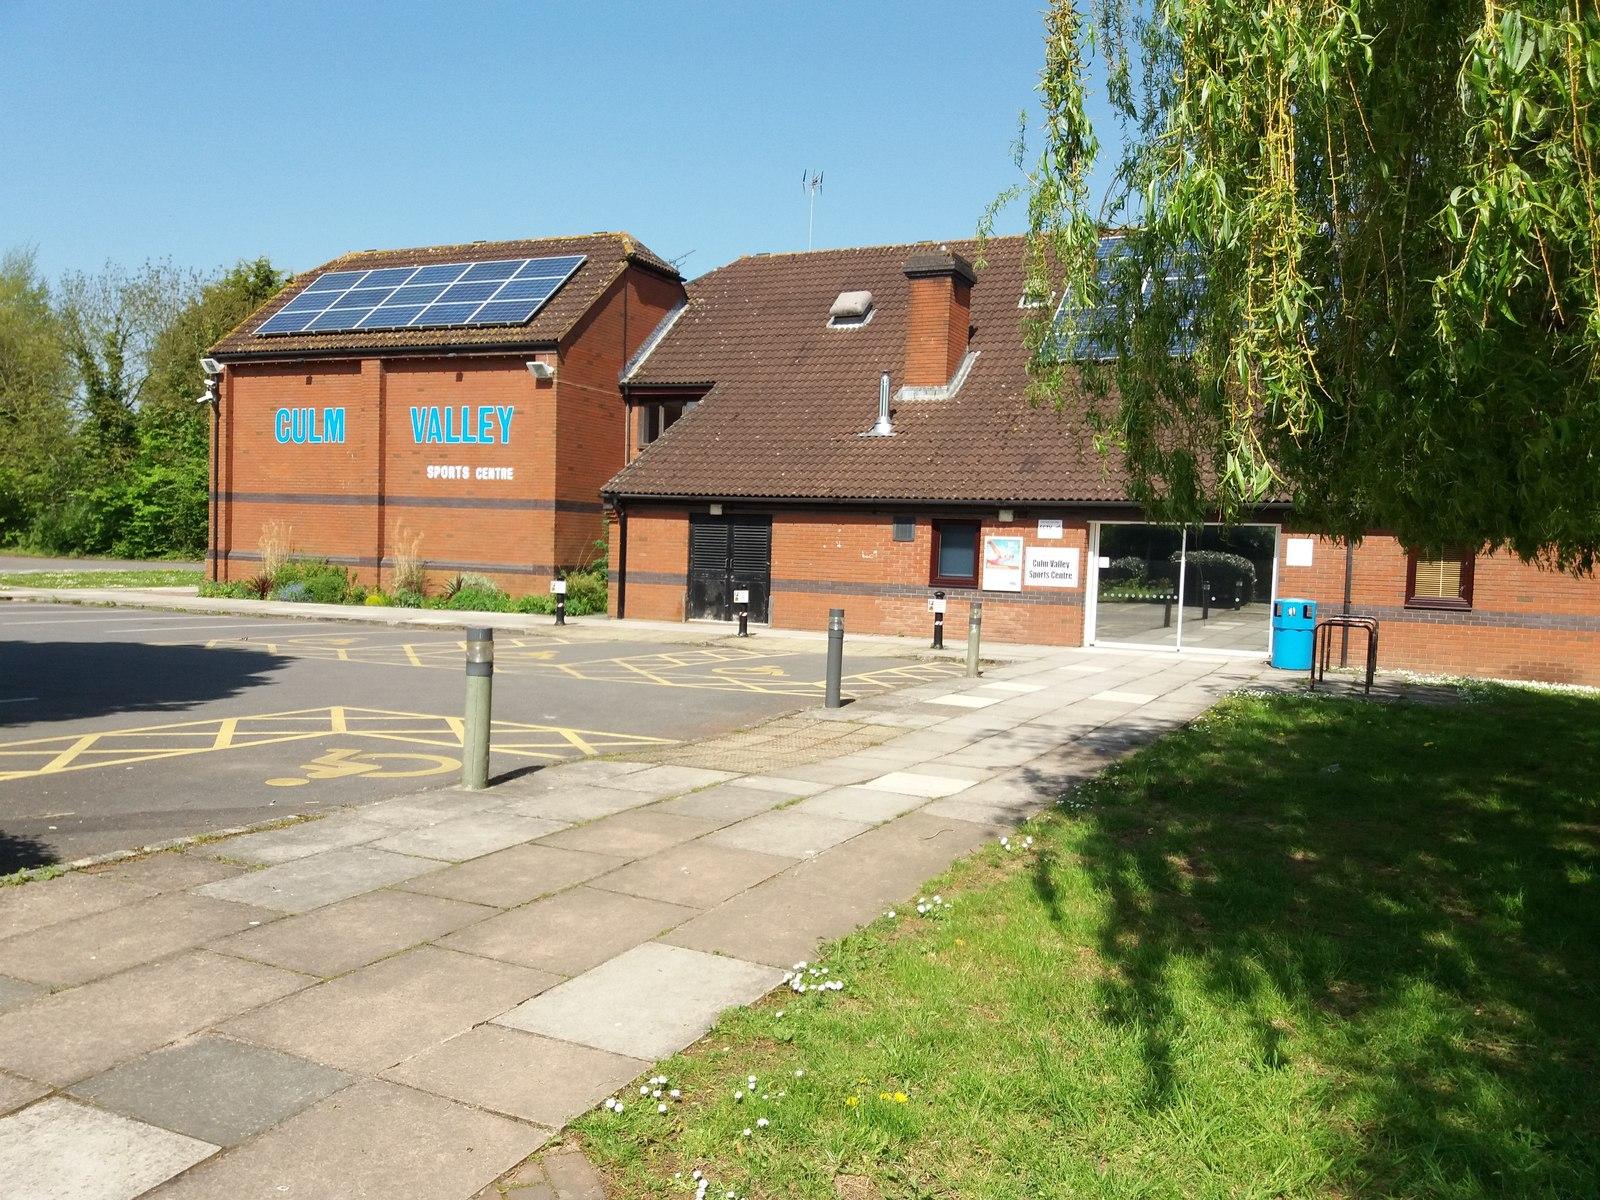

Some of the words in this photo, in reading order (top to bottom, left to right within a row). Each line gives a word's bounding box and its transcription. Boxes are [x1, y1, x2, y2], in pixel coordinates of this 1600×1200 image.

[274, 407, 346, 444] CULM
[409, 405, 515, 445] VALLEY
[426, 465, 470, 479] SPORTS
[475, 466, 514, 480] CENTRE
[1032, 559, 1049, 567] Culm
[1050, 560, 1070, 569] Valley
[1029, 570, 1050, 579] Sports
[1050, 571, 1072, 579] Centre
